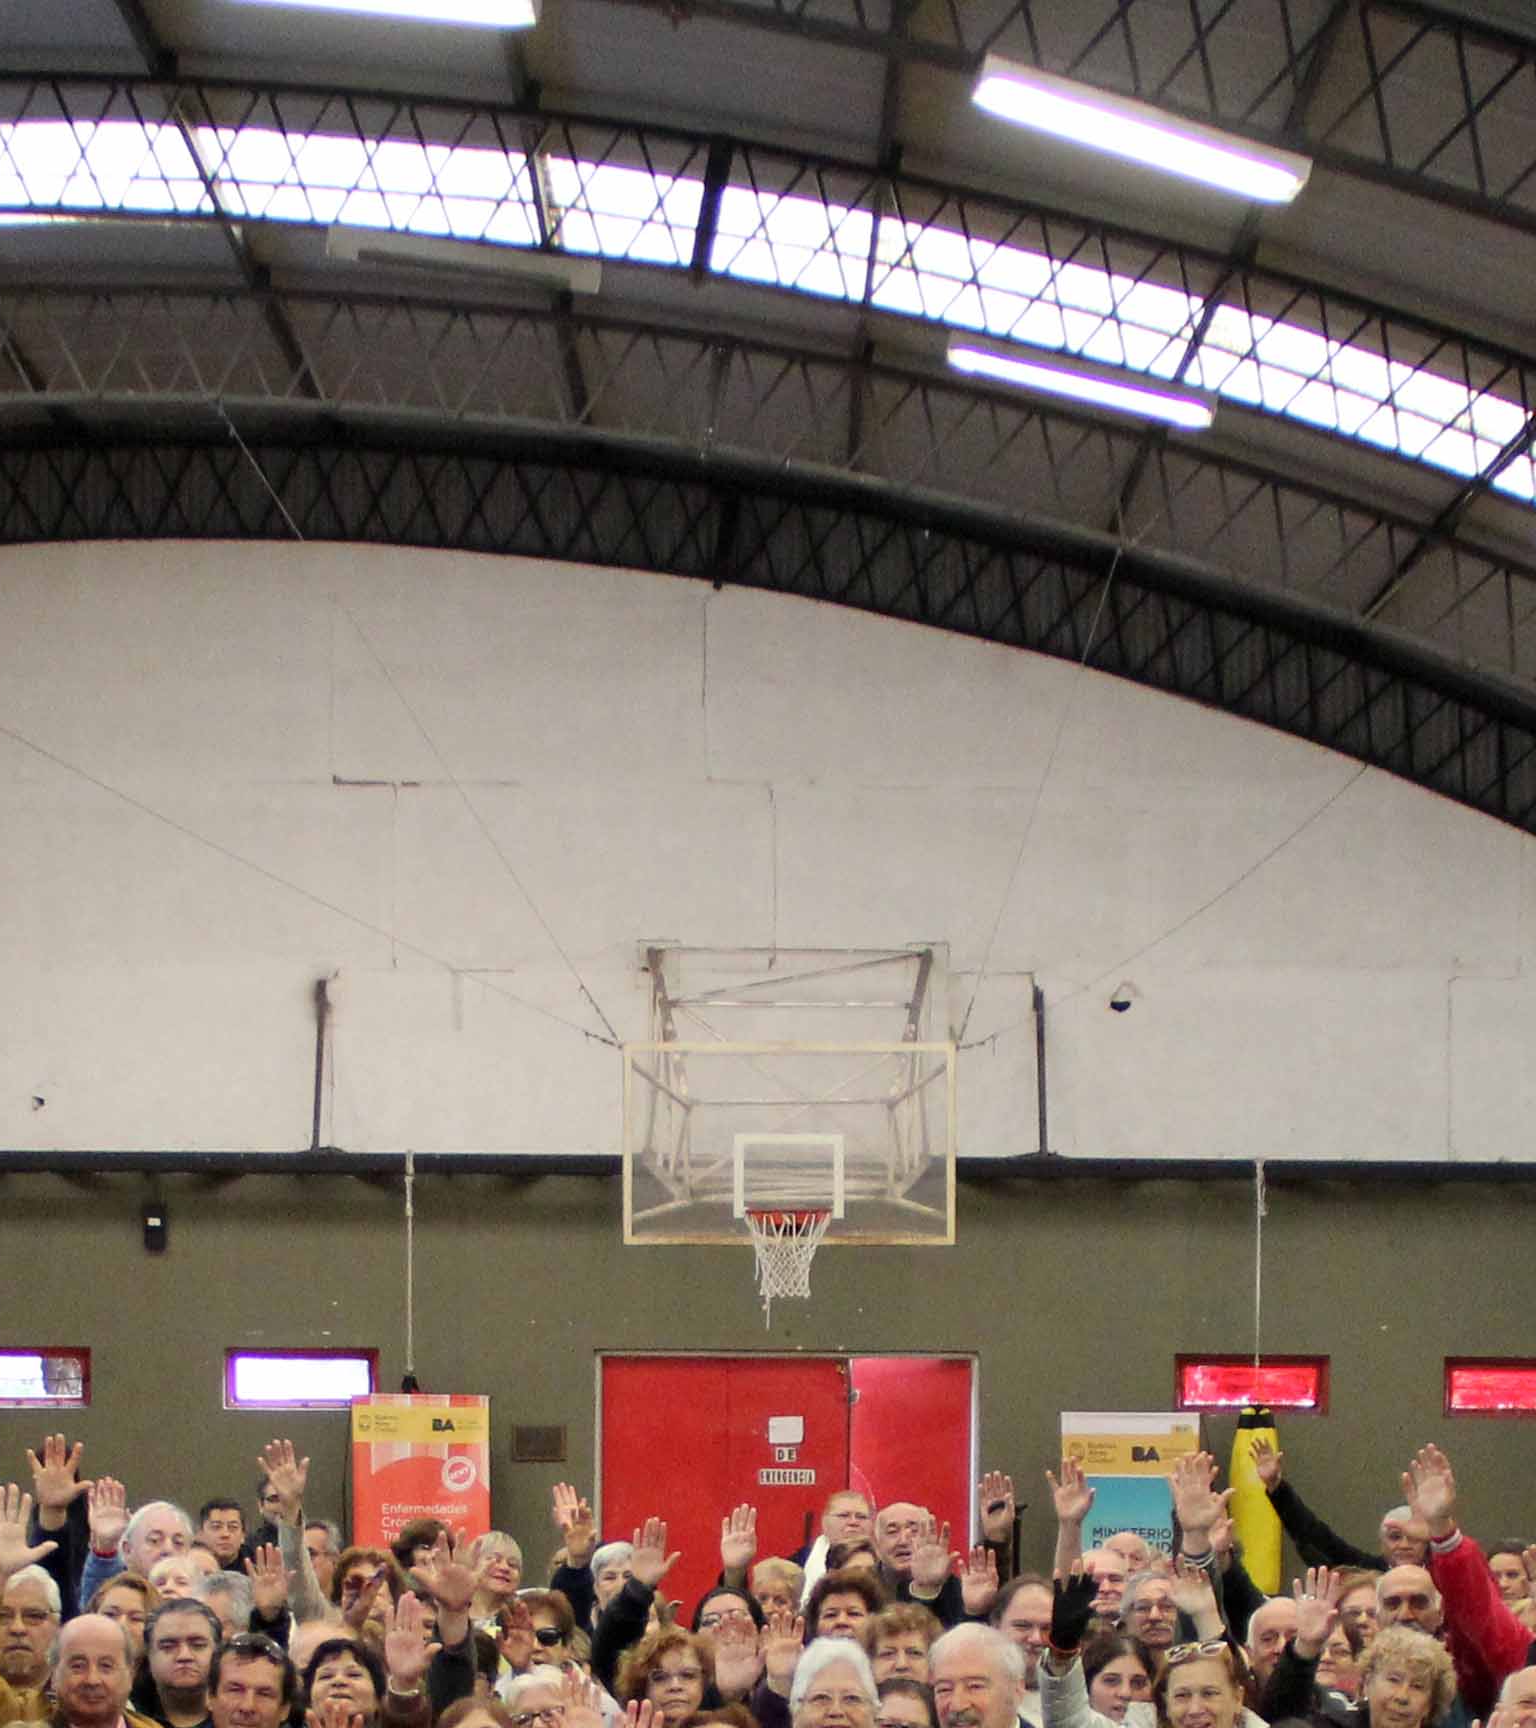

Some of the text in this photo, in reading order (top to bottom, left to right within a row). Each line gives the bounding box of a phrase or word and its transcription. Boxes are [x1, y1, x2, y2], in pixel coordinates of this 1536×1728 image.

[431, 1418, 456, 1432] BA
[777, 1448, 796, 1461] DE
[1131, 1446, 1161, 1462] BA
